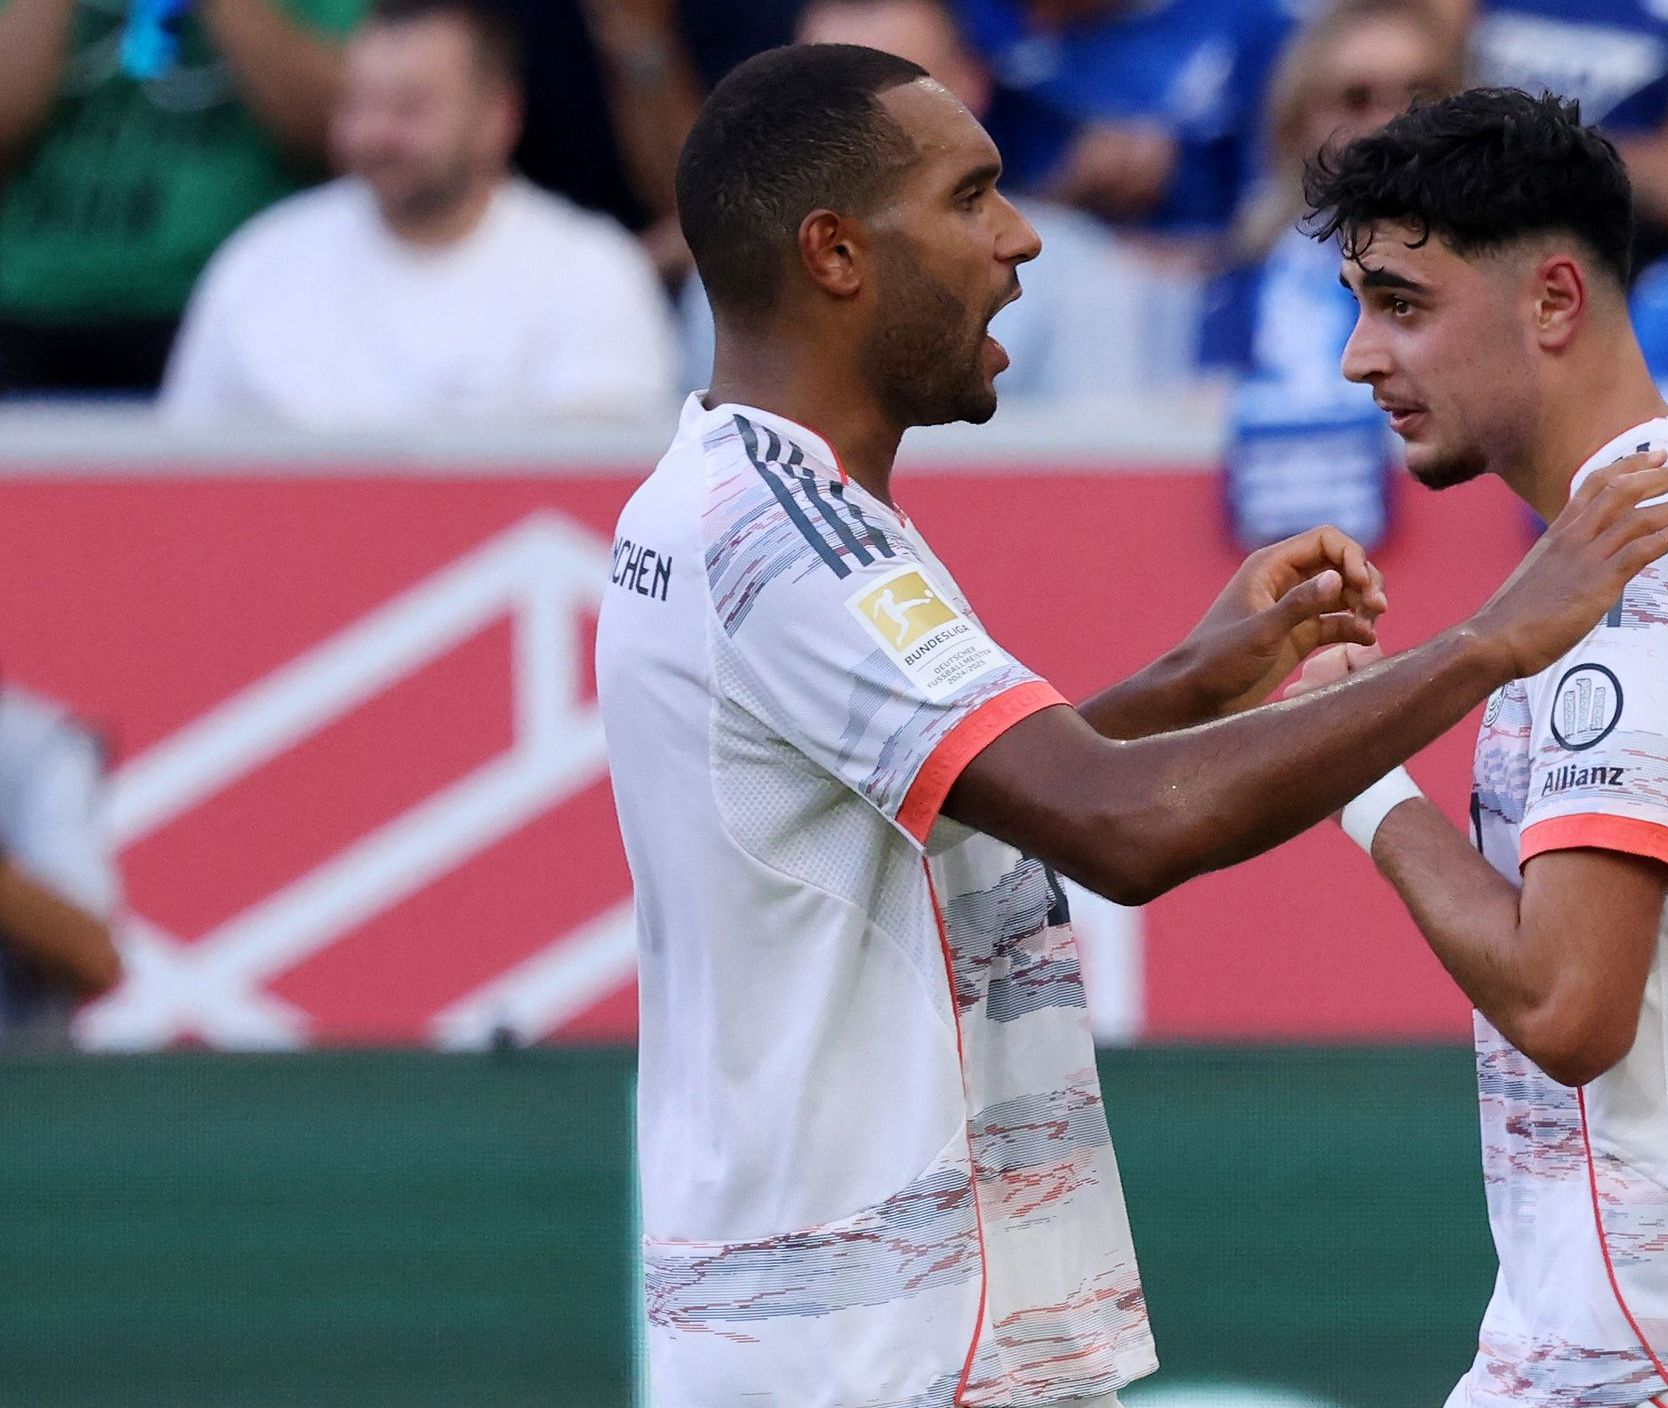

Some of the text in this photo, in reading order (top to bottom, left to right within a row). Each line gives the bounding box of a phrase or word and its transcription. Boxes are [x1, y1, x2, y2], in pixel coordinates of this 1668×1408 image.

[904, 623, 970, 666] BUNDESLIGA
[933, 646, 977, 675] DEUTSCHER
[1541, 764, 1625, 797] Allianz
